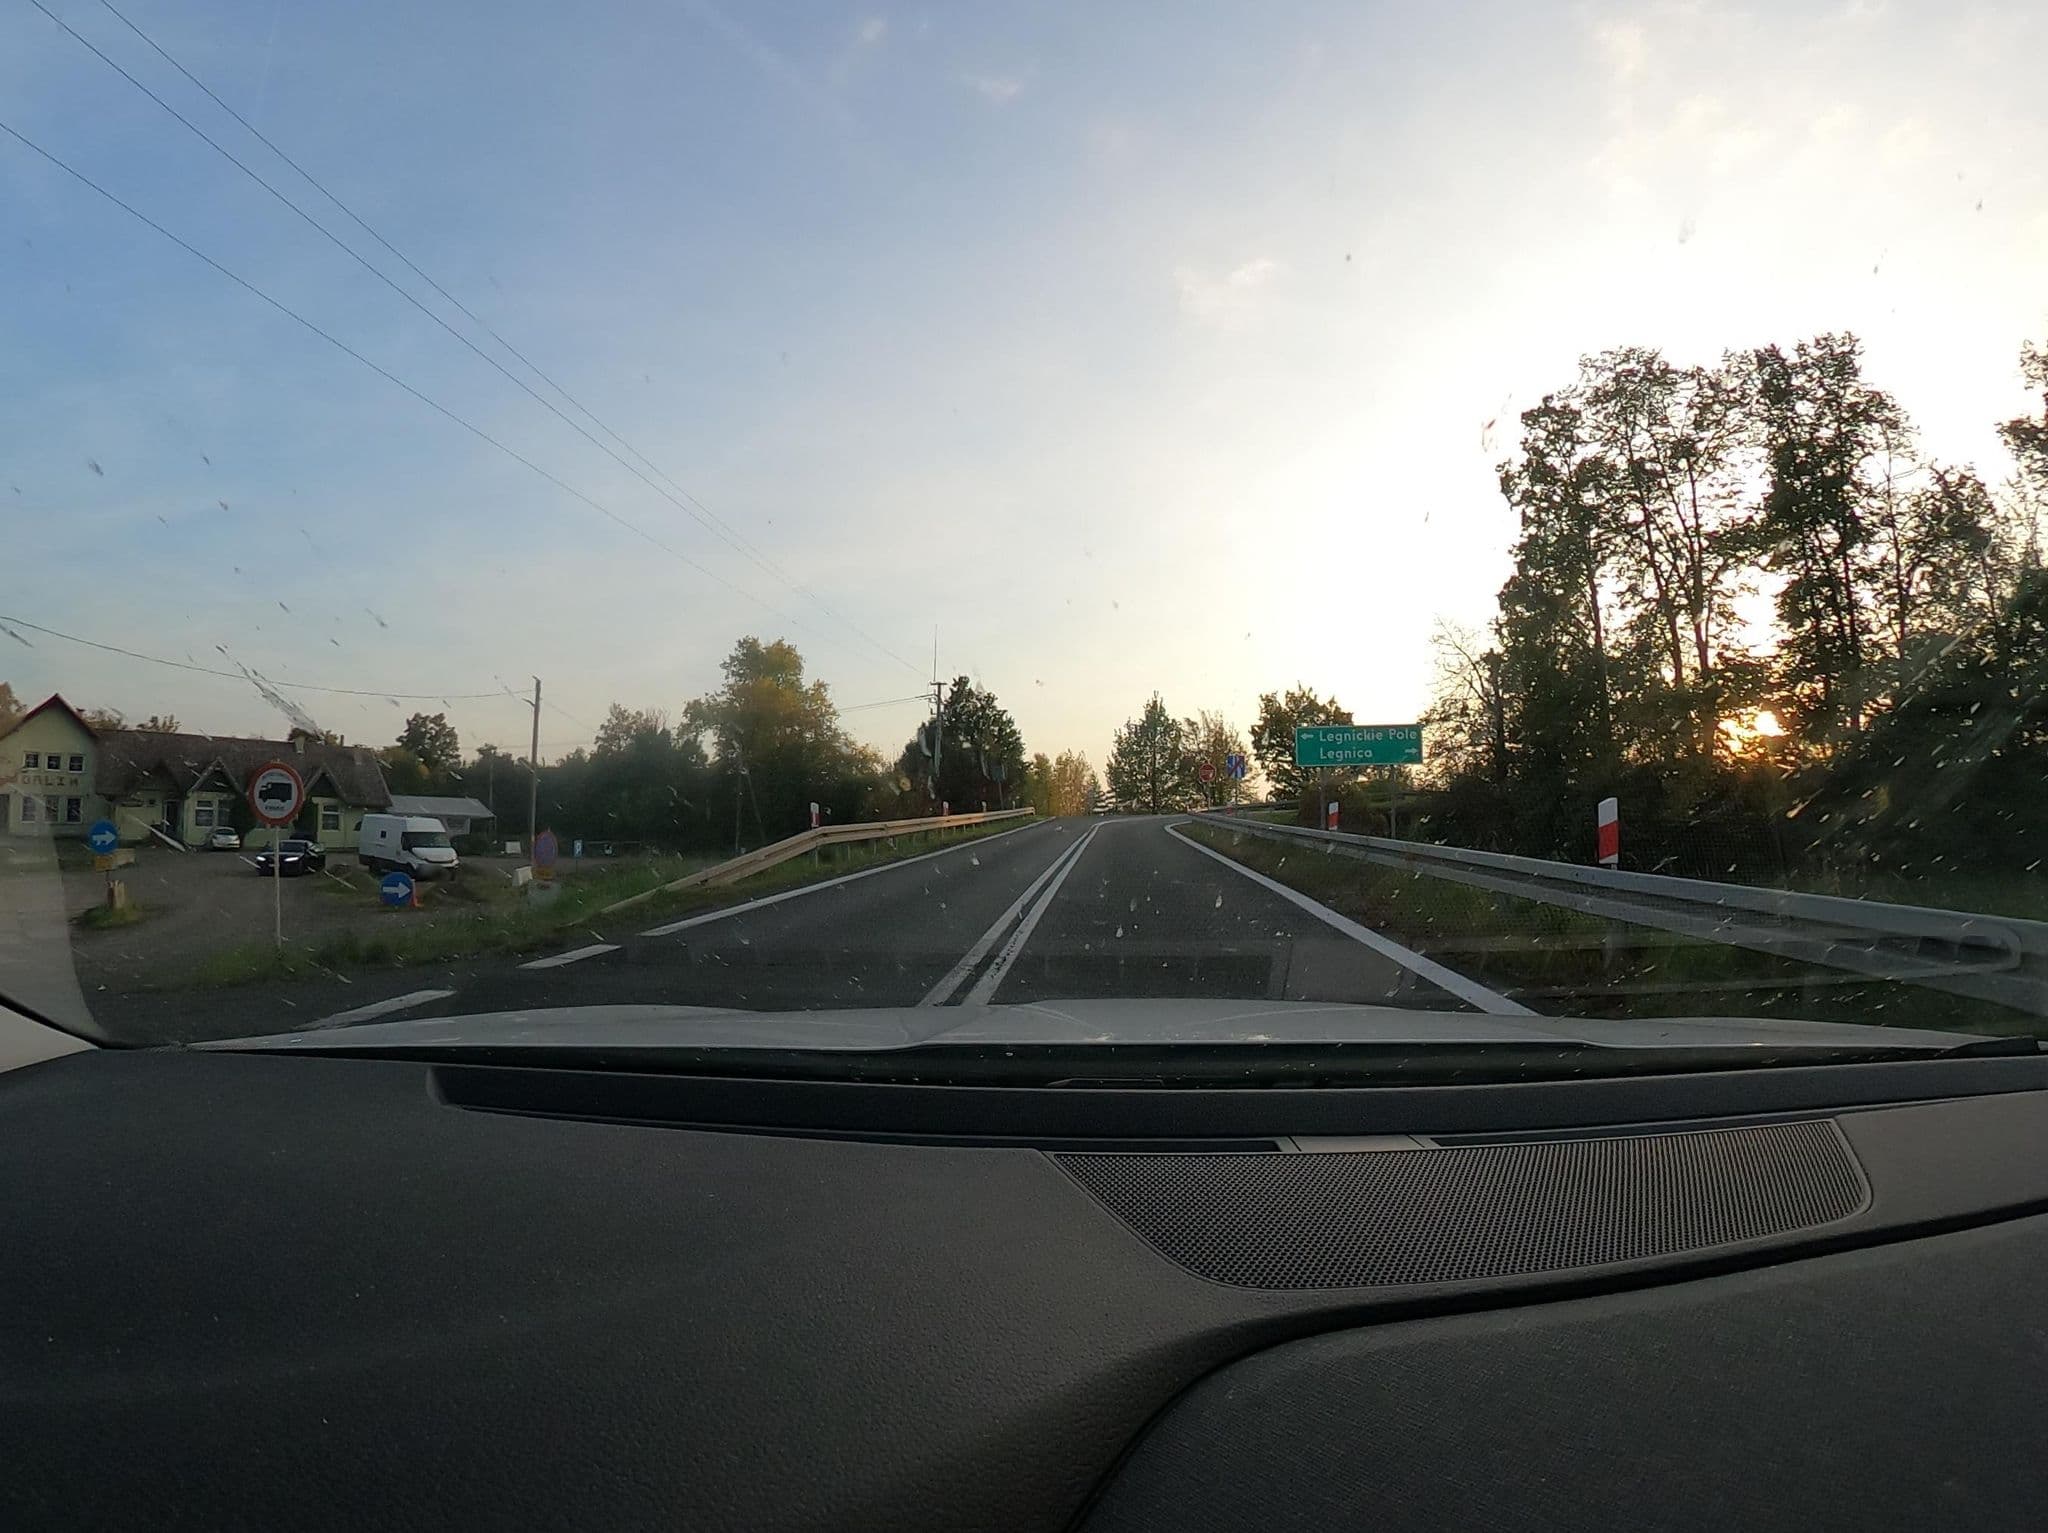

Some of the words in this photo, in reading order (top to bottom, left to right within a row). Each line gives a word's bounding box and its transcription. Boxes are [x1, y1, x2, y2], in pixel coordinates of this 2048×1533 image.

[1319, 729, 1383, 745] Legnickie
[1388, 728, 1417, 740] Pole
[1320, 746, 1373, 761] Legnica
